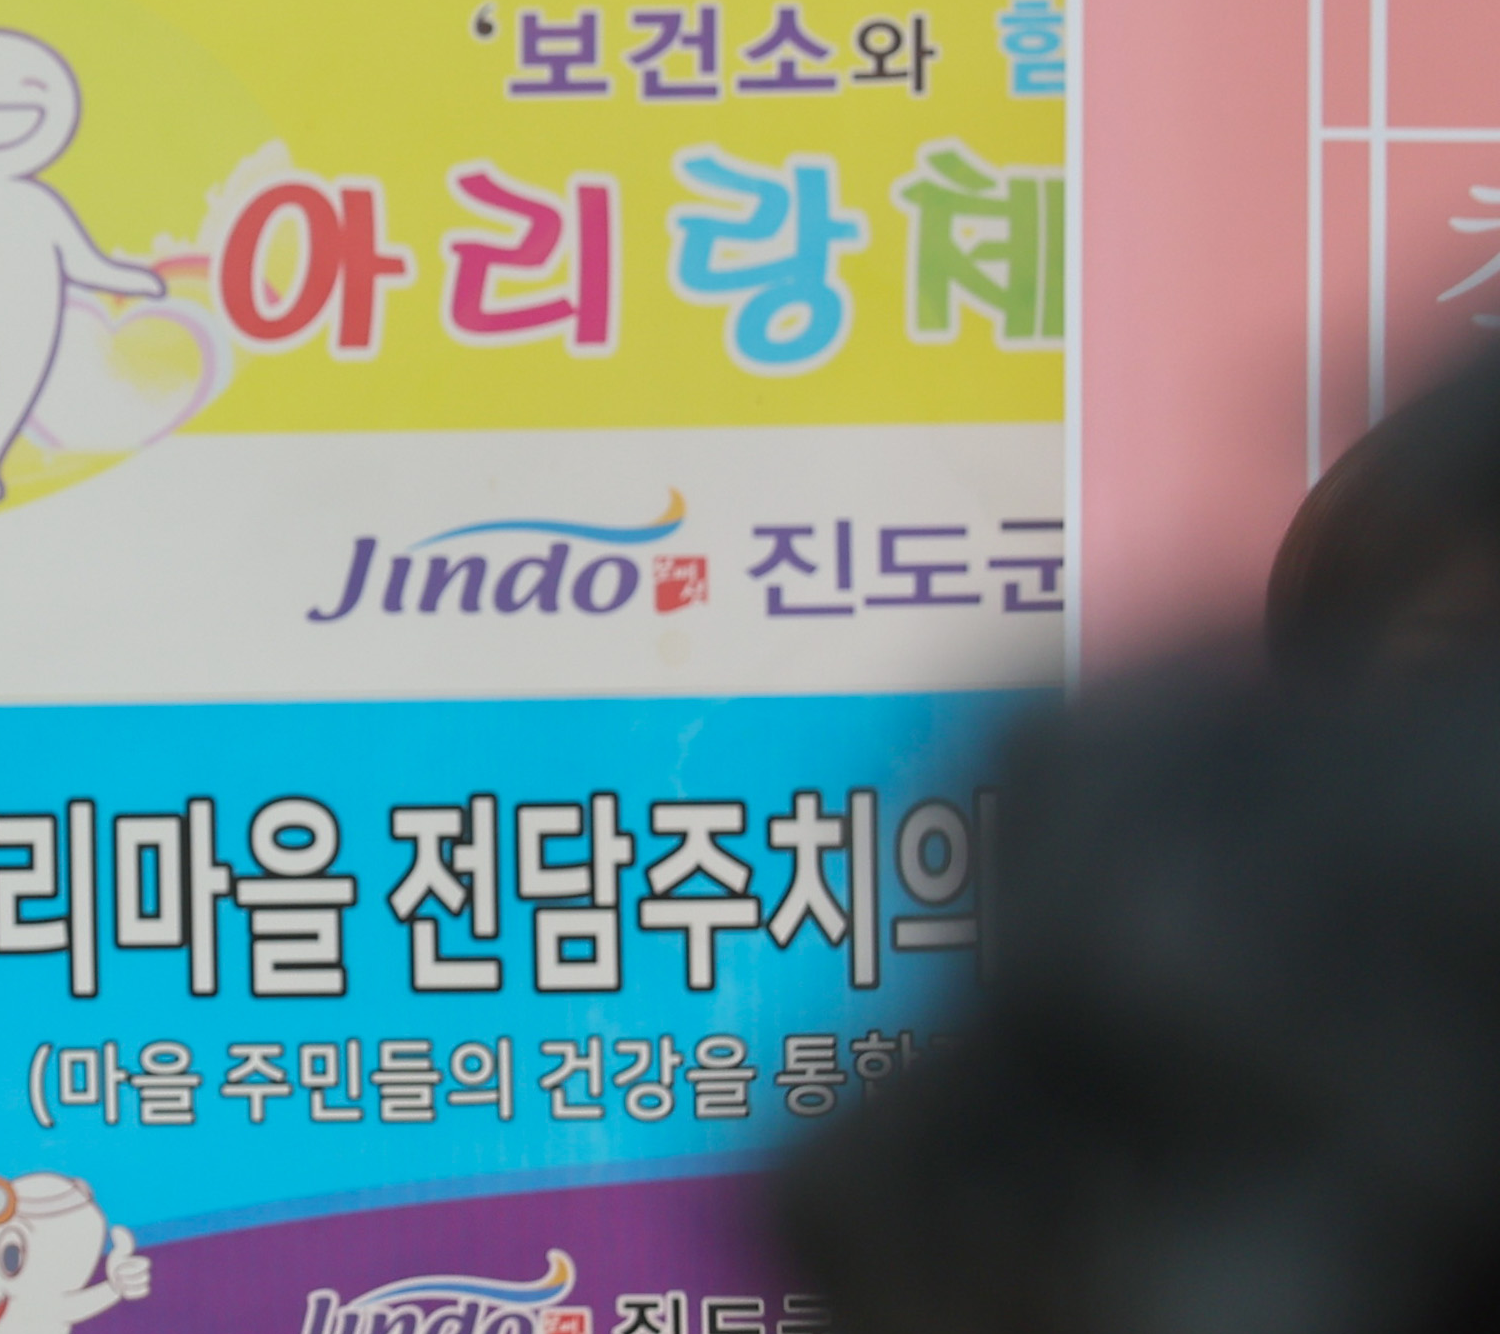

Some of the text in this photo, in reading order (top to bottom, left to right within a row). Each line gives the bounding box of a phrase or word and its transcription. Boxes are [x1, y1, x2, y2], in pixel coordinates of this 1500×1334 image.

[306, 537, 641, 623] Jindo
[28, 1037, 203, 1129] (마을
[220, 1034, 514, 1125] 주민들의
[538, 1033, 757, 1123] 건강을
